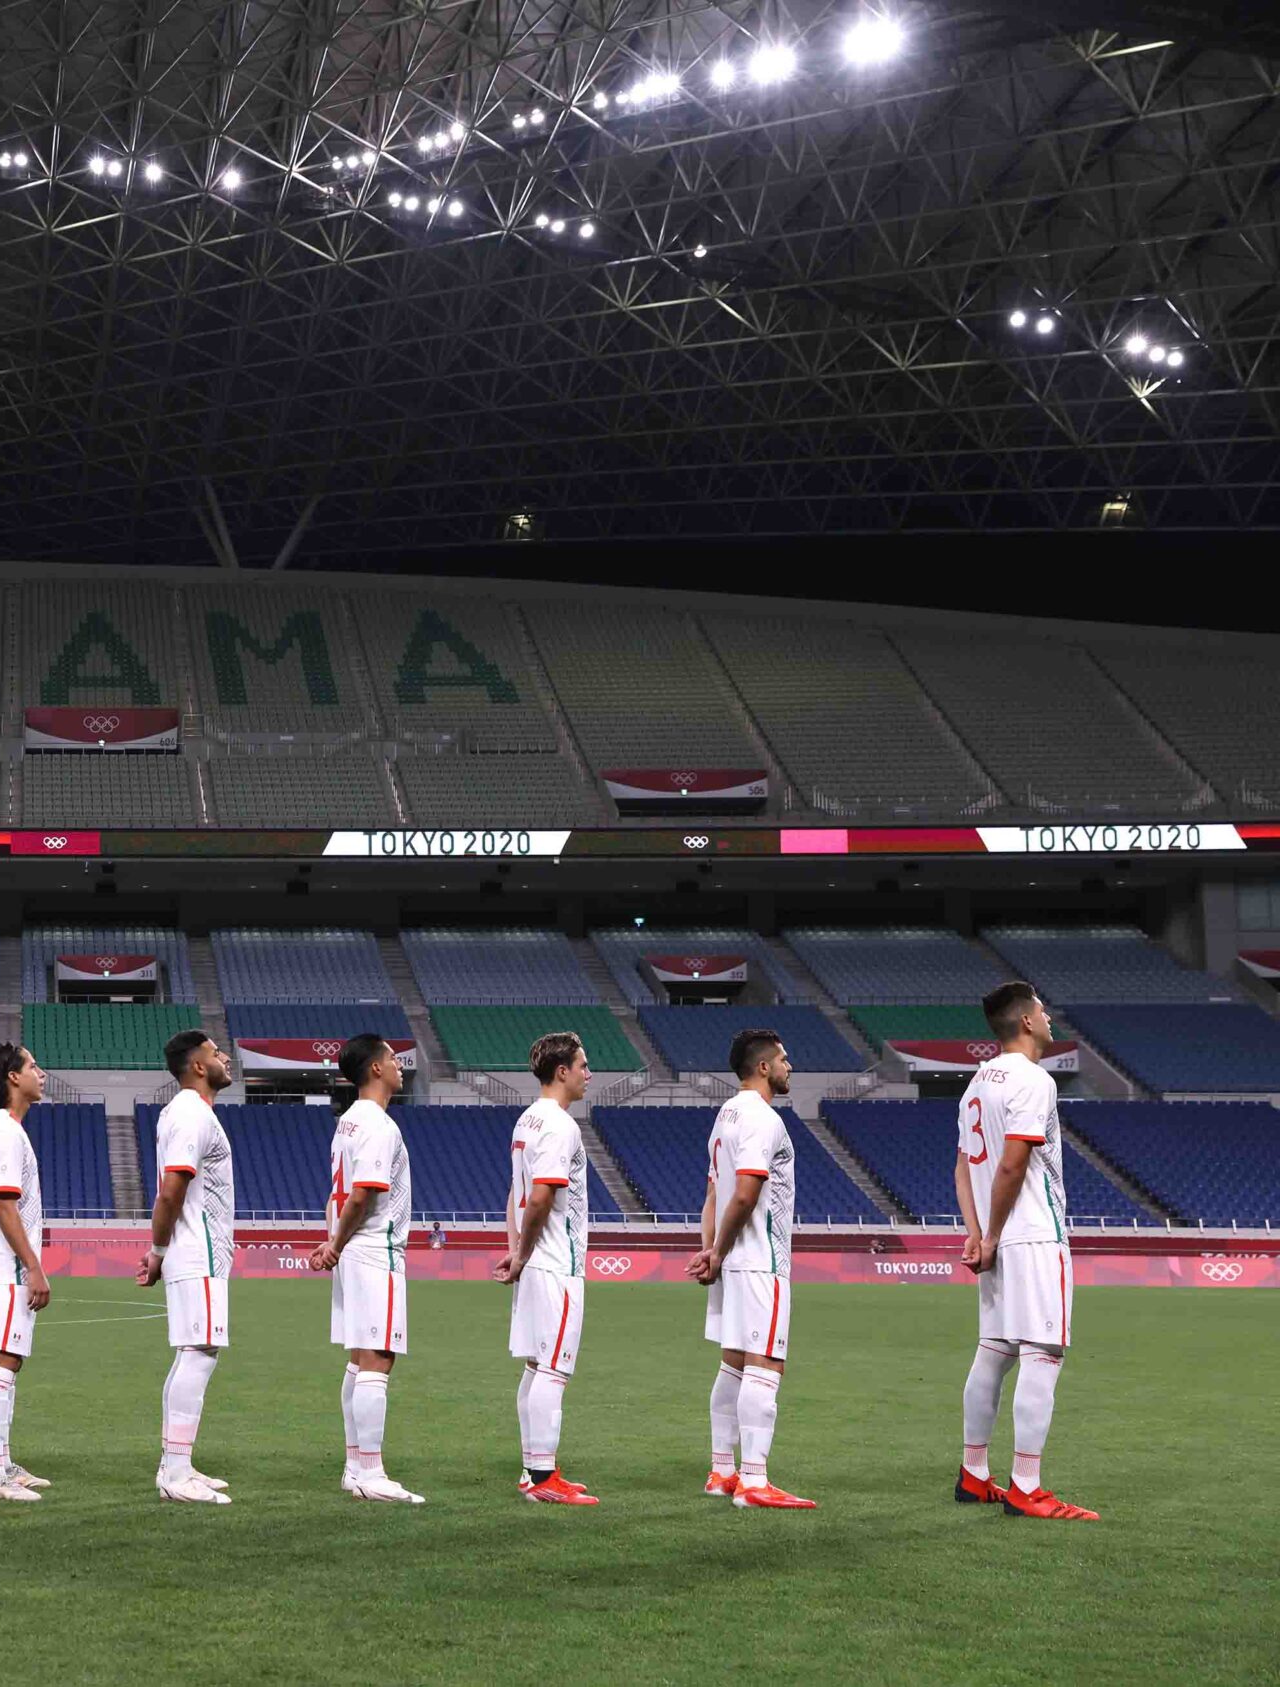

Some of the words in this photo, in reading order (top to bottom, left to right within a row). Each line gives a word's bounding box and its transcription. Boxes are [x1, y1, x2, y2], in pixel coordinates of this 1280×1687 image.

[363, 830, 455, 855] TOKYO
[463, 830, 531, 856] 2020
[1020, 826, 1118, 851] TOKYO
[1128, 825, 1201, 850] 2020
[1057, 1058, 1076, 1069] 217
[967, 1096, 988, 1165] 3
[278, 1257, 310, 1269] TOKY
[875, 1262, 918, 1274] TOKYO
[920, 1262, 953, 1275] 2020
